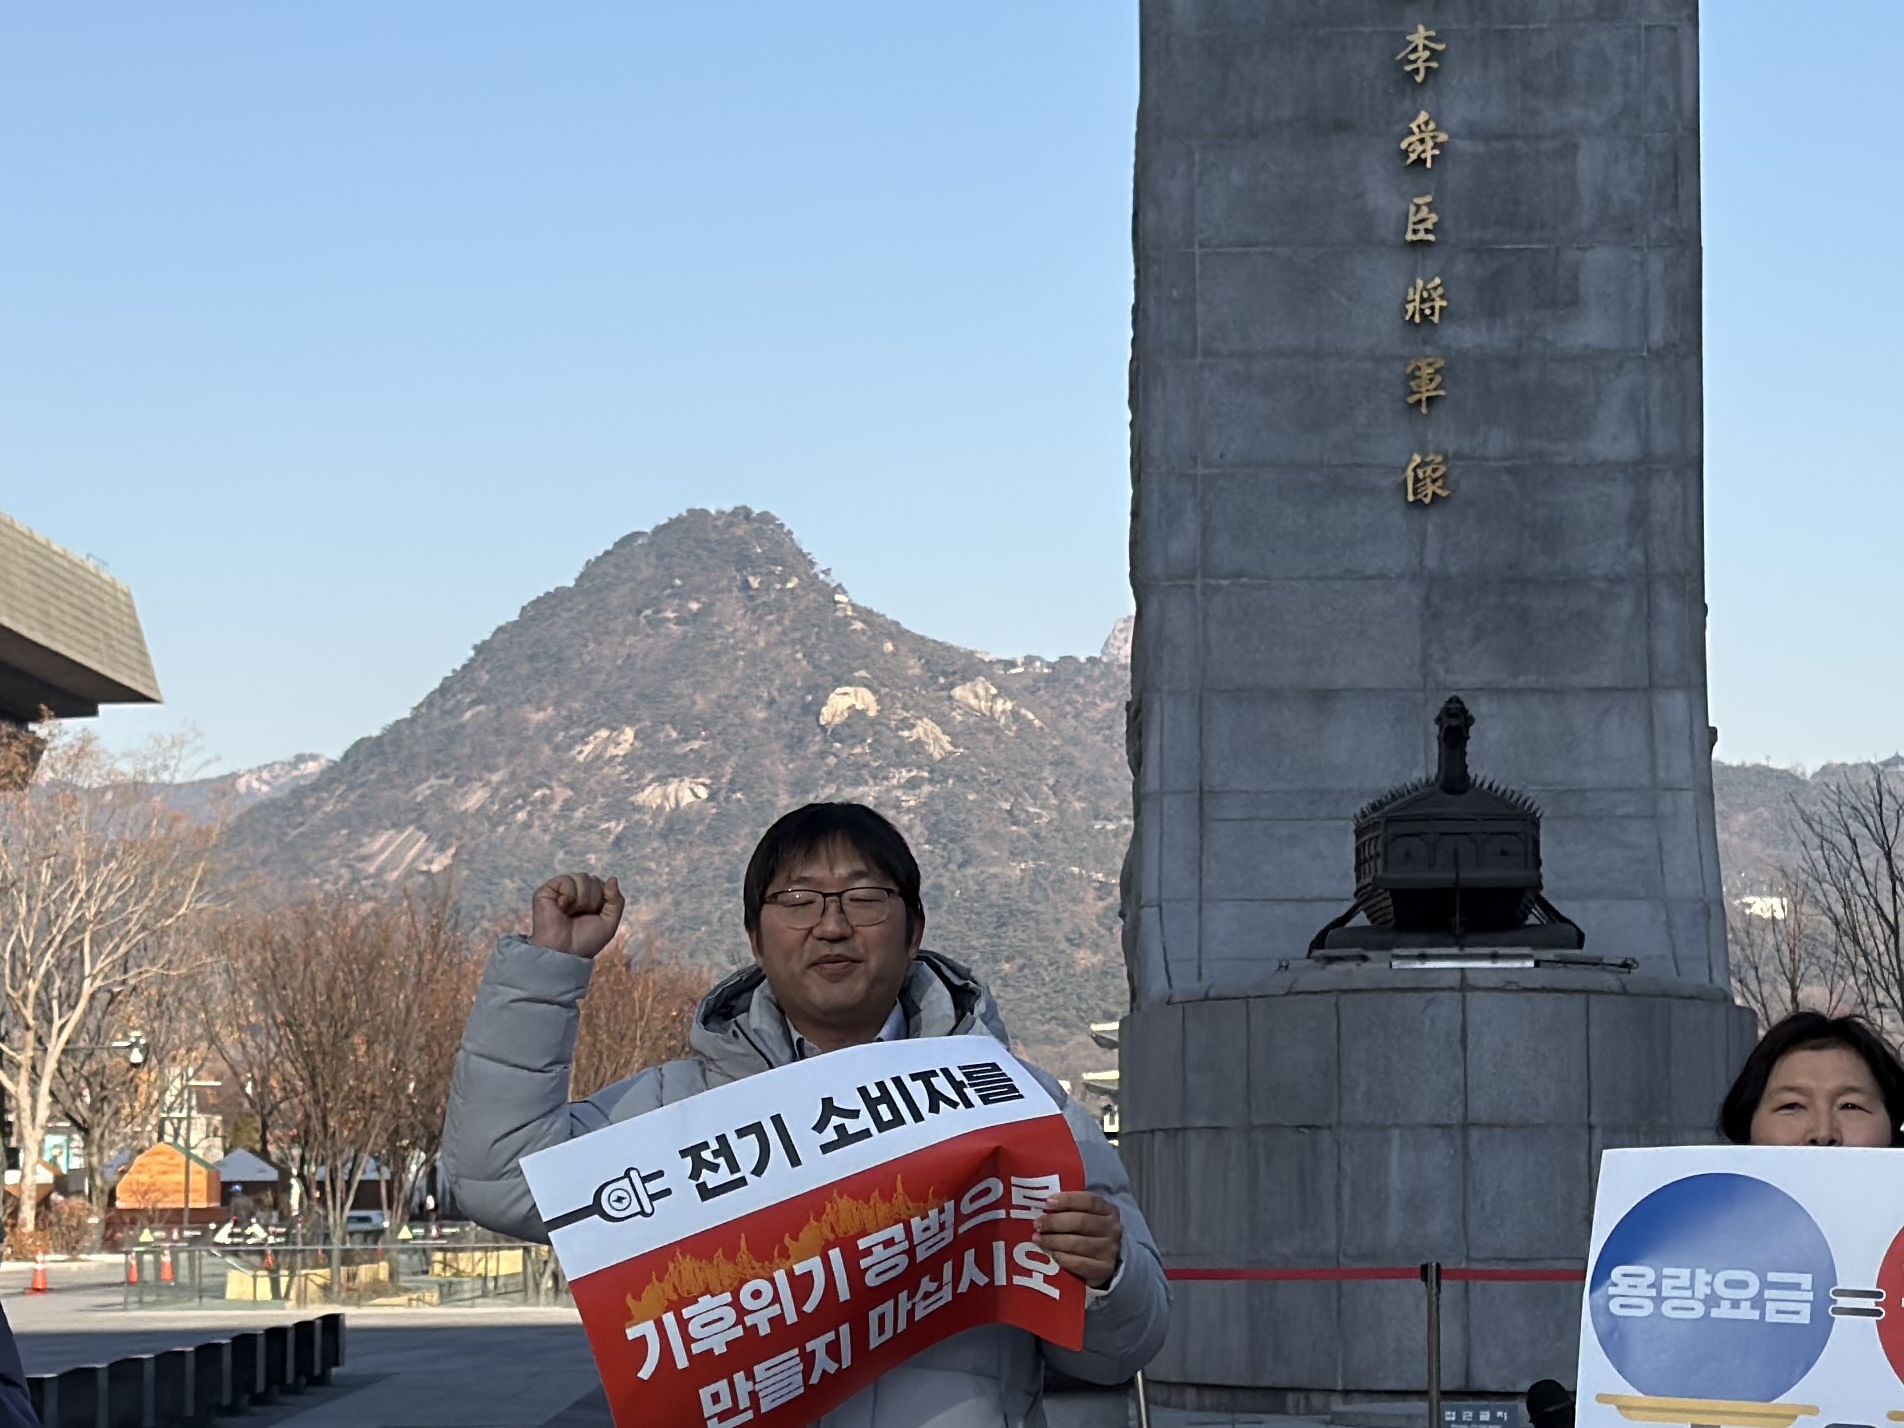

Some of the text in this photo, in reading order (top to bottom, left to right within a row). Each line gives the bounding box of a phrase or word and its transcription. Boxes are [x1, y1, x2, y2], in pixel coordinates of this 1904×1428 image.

[678, 1062, 1024, 1202] 전기 소비자를
[625, 1173, 1062, 1381] 기후위기 공범으로
[868, 1240, 1062, 1350] 마십시오
[1606, 1264, 1815, 1325] 용량요금
